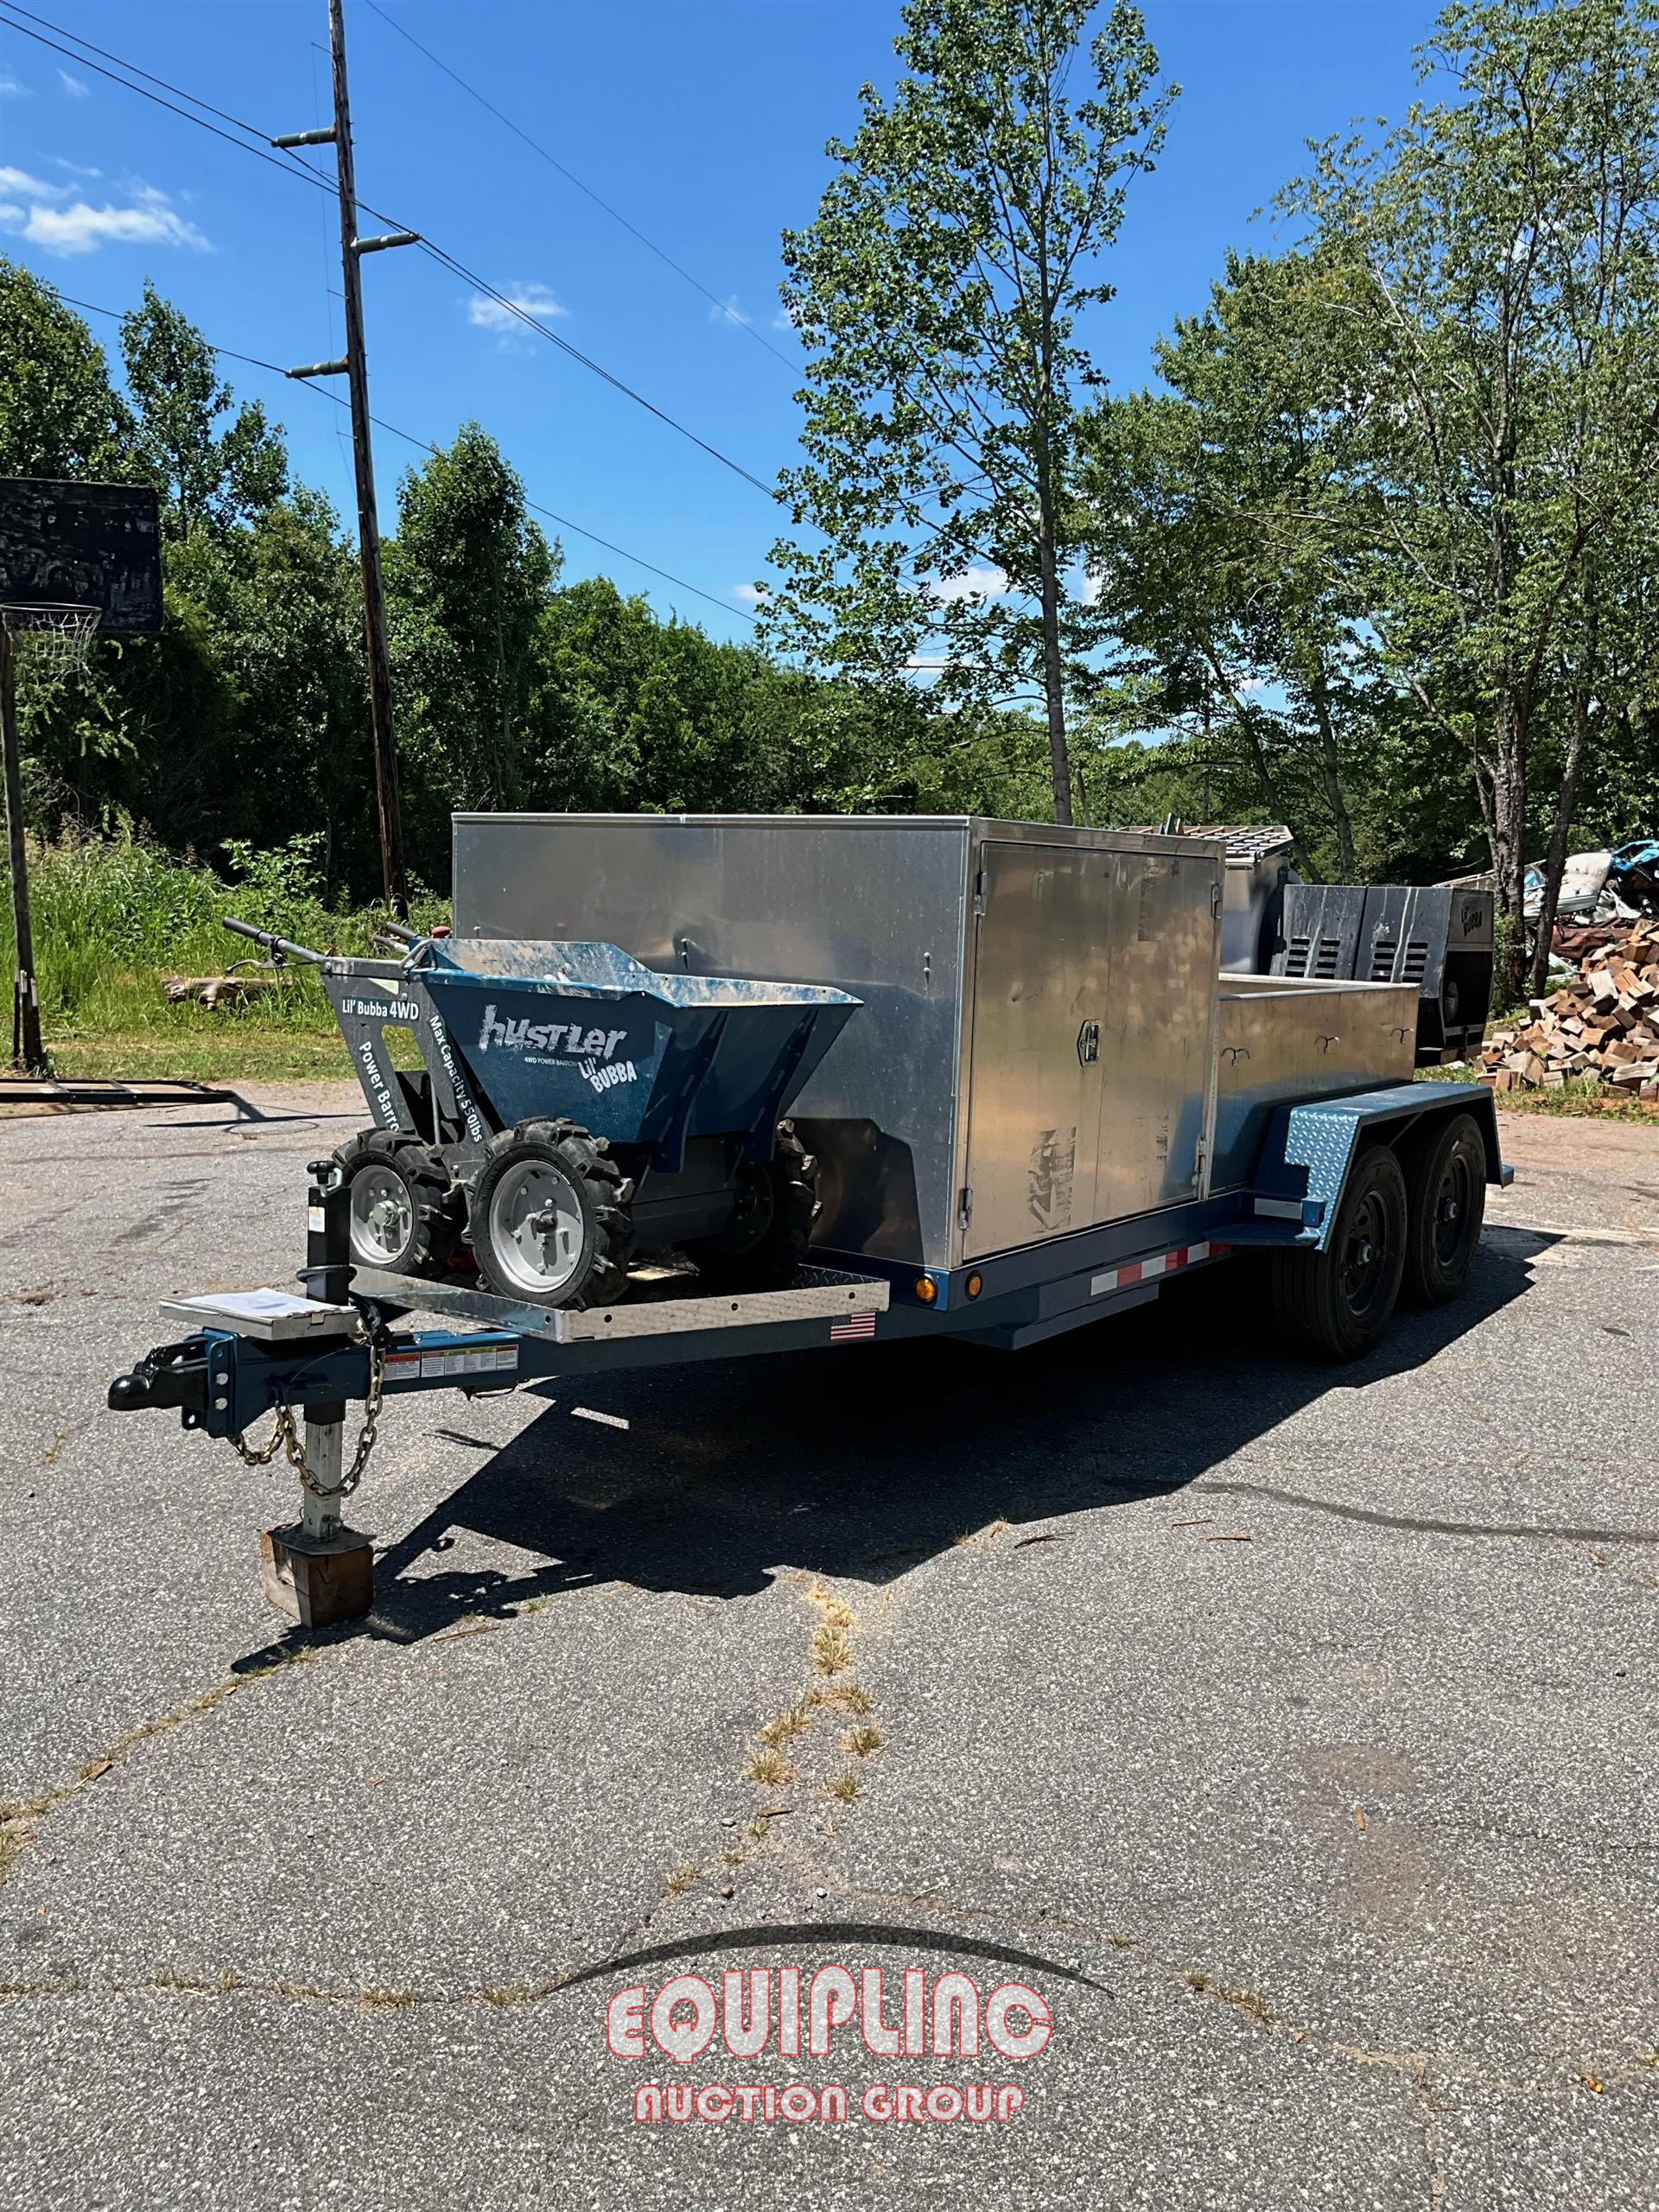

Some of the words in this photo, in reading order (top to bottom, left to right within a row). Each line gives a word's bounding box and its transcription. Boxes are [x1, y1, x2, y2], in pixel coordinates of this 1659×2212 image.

[358, 1001, 388, 1017] Bubba
[389, 1001, 419, 1020] 4WD
[359, 1040, 385, 1090] Power
[377, 1090, 400, 1132] Barro
[429, 1014, 446, 1046] Max
[441, 1045, 467, 1099] Capacity
[461, 1099, 483, 1143] 550lbs
[589, 1060, 638, 1093] BUBBA
